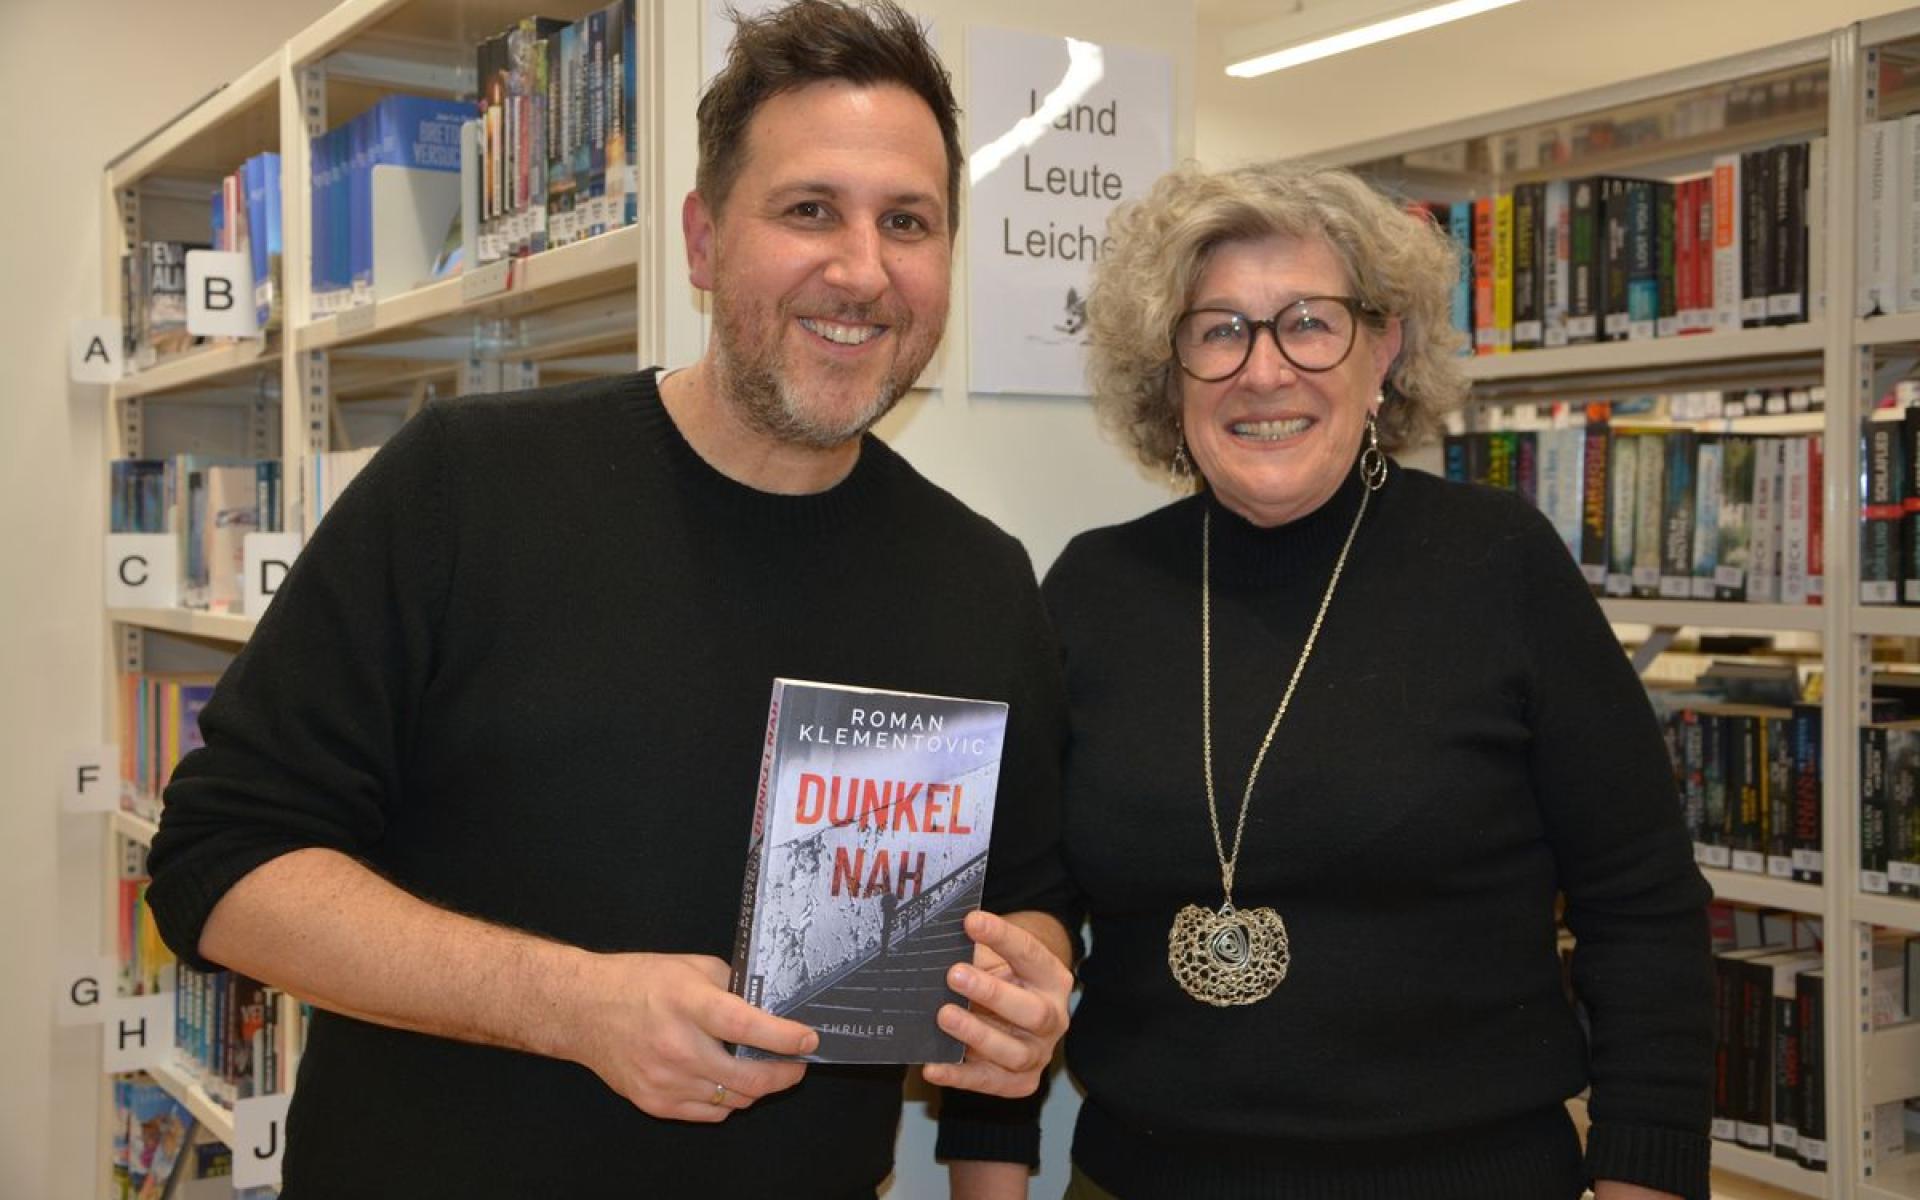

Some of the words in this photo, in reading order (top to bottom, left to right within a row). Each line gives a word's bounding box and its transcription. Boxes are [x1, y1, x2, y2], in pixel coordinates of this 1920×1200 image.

[1024, 154, 1122, 200] Leute
[1004, 217, 1117, 262] Leiche
[205, 277, 233, 310] B
[84, 335, 109, 362] A
[119, 555, 149, 587] C
[261, 560, 290, 595] D
[766, 700, 779, 747] NAH
[851, 708, 944, 732] ROMAN
[799, 724, 986, 755] KLEMENTOVIC
[77, 765, 100, 793] F
[795, 773, 971, 835] DUNKEL
[831, 847, 926, 900] NAH
[71, 977, 99, 1006] G
[119, 1019, 147, 1050] H
[821, 1023, 895, 1036] THRILLER
[254, 1122, 277, 1160] J
